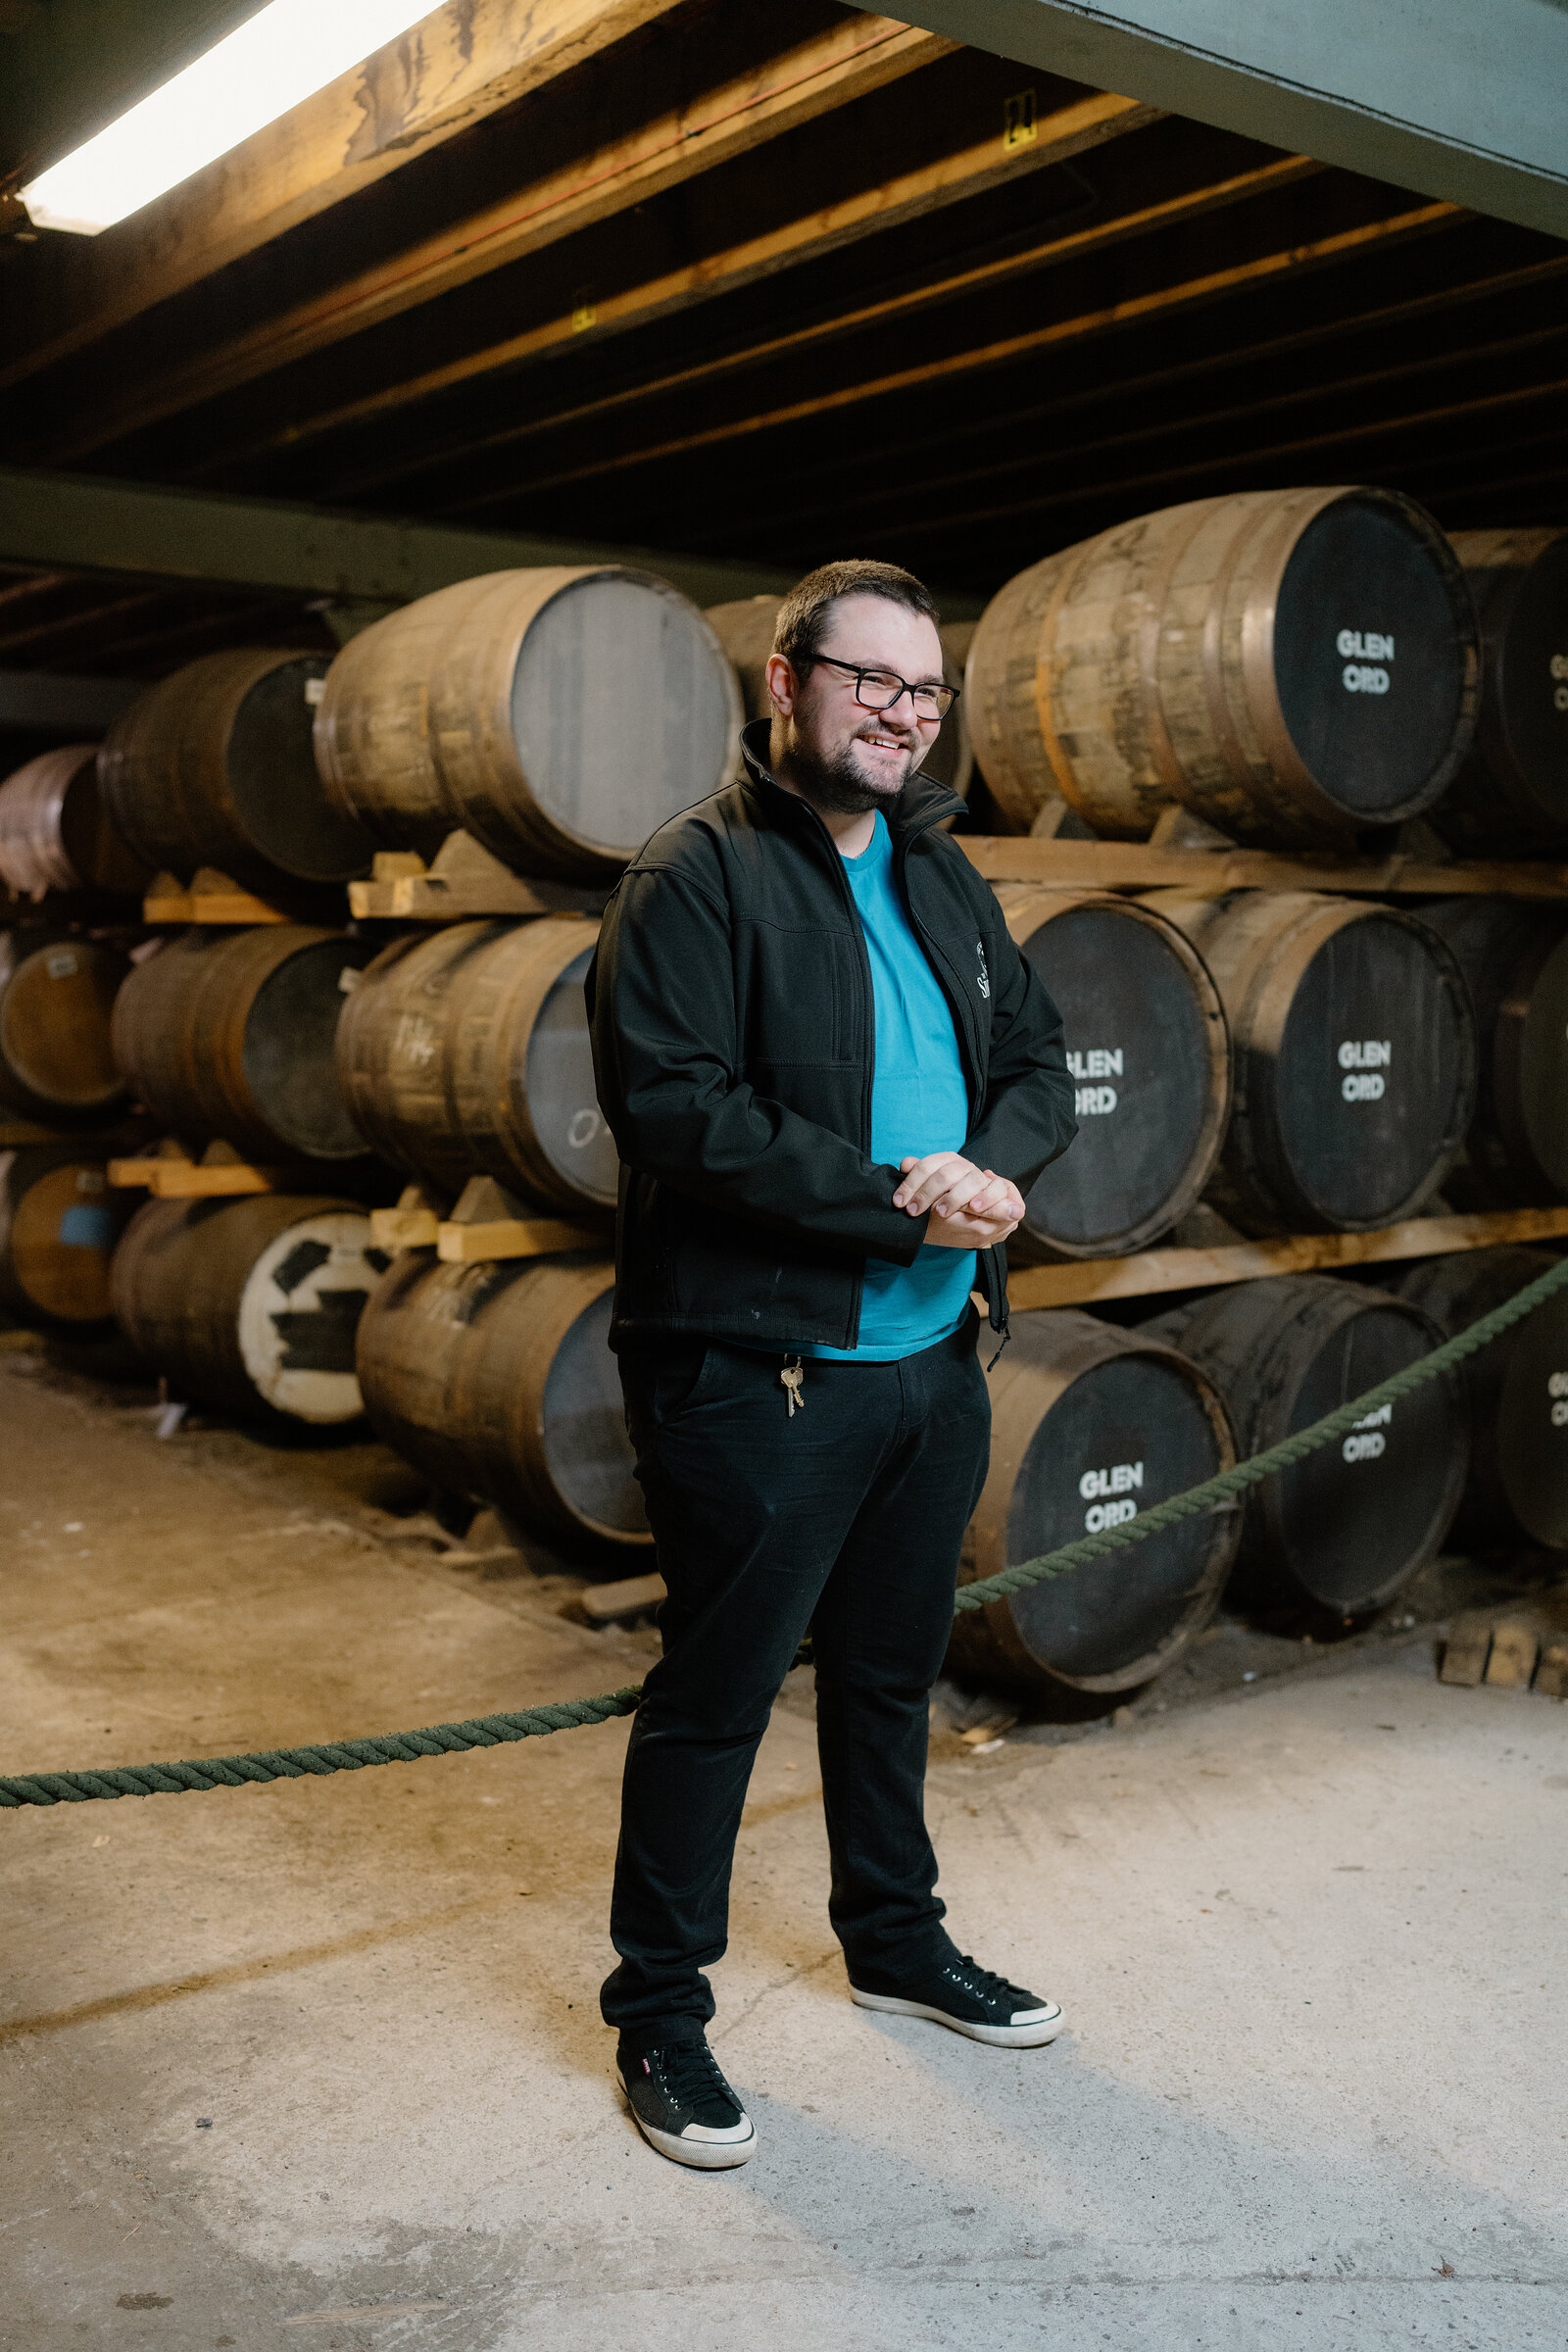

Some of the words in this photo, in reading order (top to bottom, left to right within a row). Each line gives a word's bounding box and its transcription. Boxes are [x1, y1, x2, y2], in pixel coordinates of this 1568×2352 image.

[1337, 629, 1395, 661] GLEN
[1343, 663, 1391, 694] ORD
[1337, 1041, 1392, 1069] GLEN
[1075, 1087, 1117, 1116] RD
[1342, 1074, 1386, 1102] ORD
[1343, 1432, 1386, 1462] ORD
[1079, 1460, 1144, 1500] GLEN
[1085, 1498, 1137, 1534] ORD
